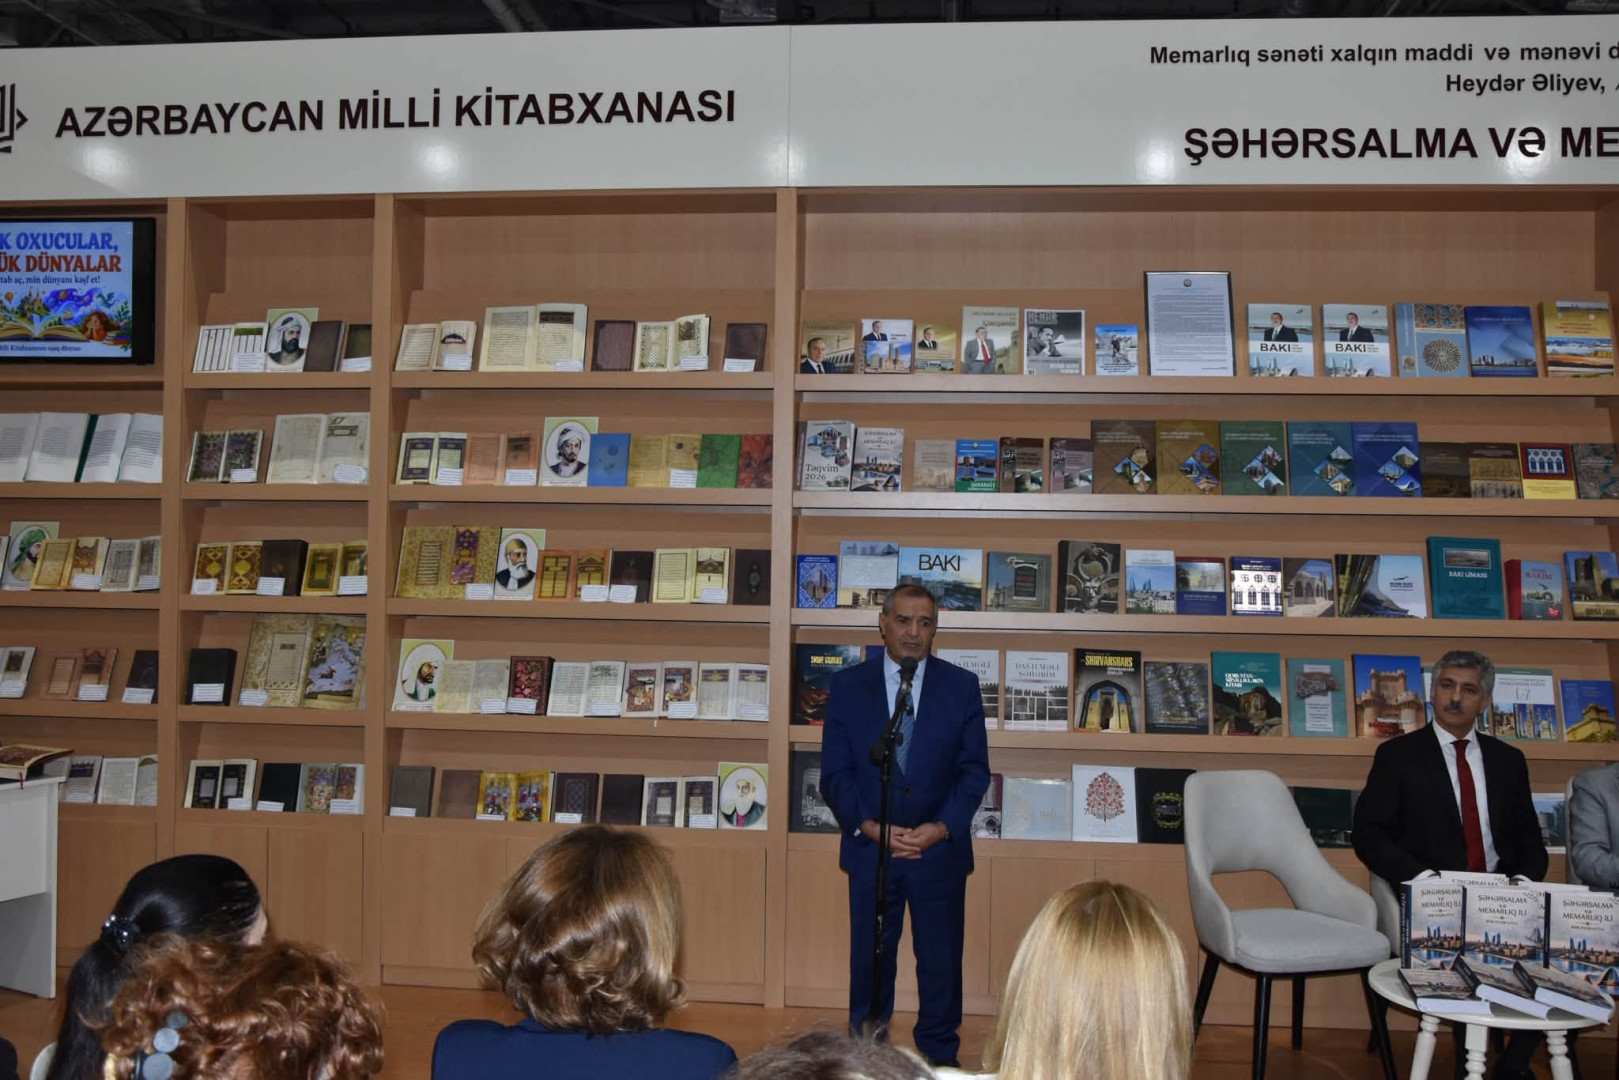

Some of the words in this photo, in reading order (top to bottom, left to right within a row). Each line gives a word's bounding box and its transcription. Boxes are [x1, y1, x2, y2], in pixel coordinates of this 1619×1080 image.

[1150, 45, 1250, 67] Memarlıq
[1257, 45, 1324, 64] sənəti
[1330, 44, 1398, 65] xalqın
[1405, 43, 1473, 62] maddi
[1484, 47, 1511, 61] və
[1520, 42, 1601, 60] mənəvi
[1446, 74, 1525, 95] Heydər
[1532, 73, 1605, 95] Əliyev,
[55, 100, 324, 138] AZƏRBAYCAN
[339, 89, 441, 130] MİLLİ
[455, 86, 735, 127] KİTABXANASI
[1184, 127, 1478, 166] ŞƏHƏRSALMA
[1488, 126, 1547, 158] VƏ
[1560, 126, 1619, 157] ME
[16, 232, 119, 252] OXUCULAR,
[25, 251, 122, 272] DÜNYALAR
[26, 275, 40, 284] min
[1260, 343, 1291, 352] BAKI
[1335, 343, 1366, 352] BAKI
[918, 554, 961, 572] BAKI
[1478, 907, 1518, 917] MEMARLIQ
[1562, 912, 1603, 922] MEMARLIQ
